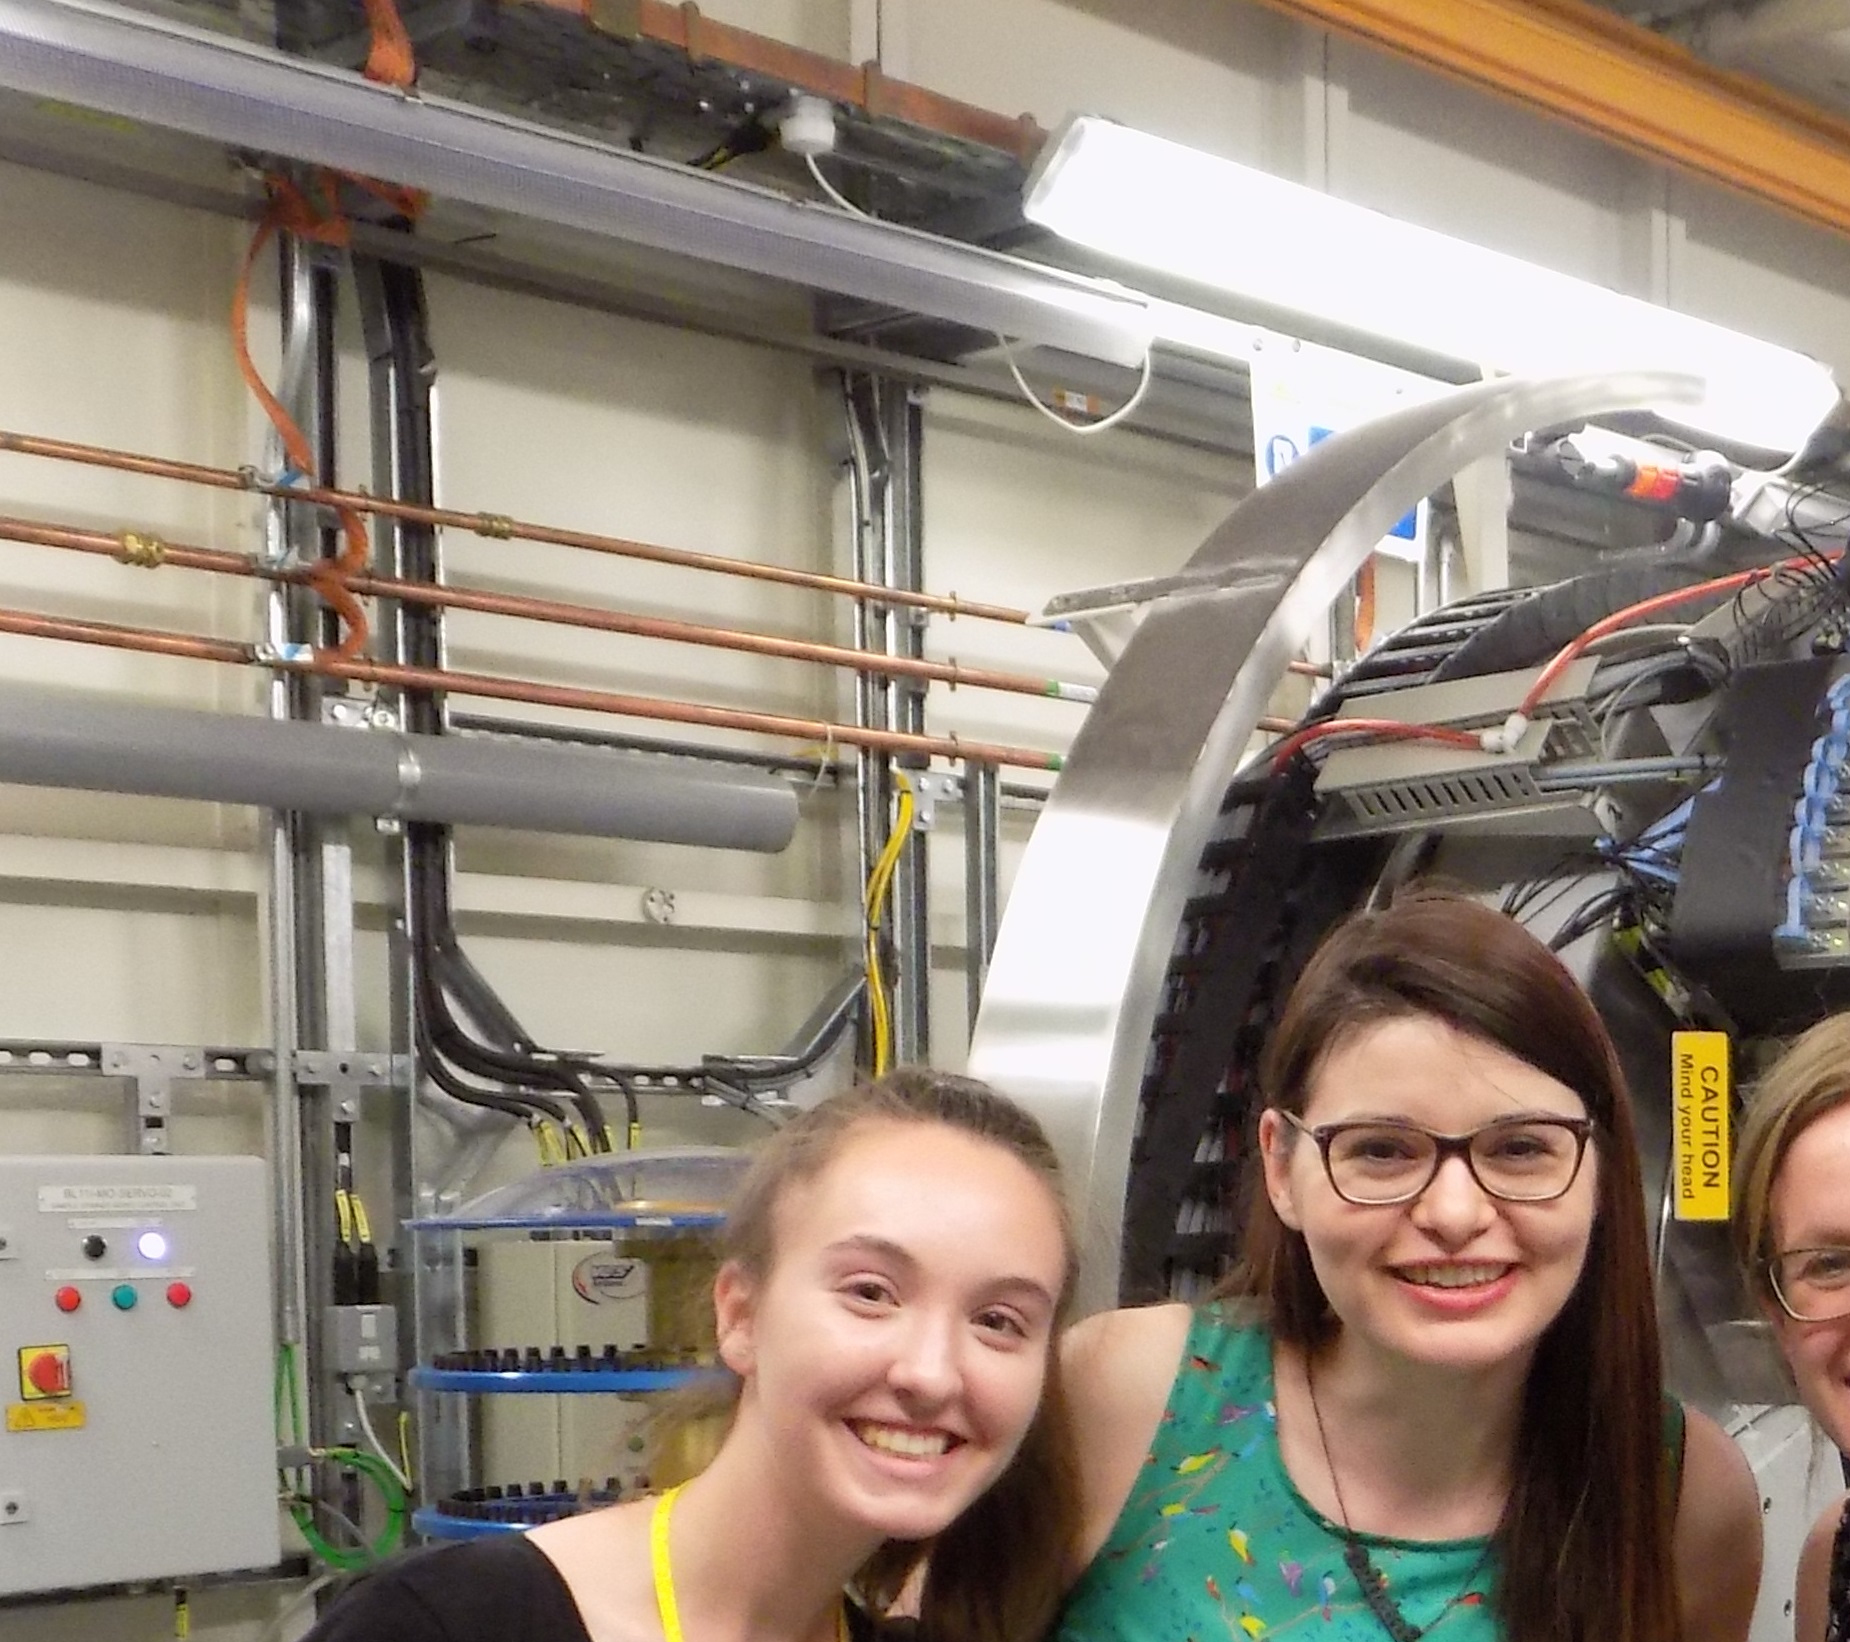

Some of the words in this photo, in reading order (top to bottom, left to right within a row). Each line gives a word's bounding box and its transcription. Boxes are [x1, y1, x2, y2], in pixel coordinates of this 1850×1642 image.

[1679, 1053, 1694, 1098] Mind
[1678, 1105, 1693, 1147] your
[1700, 1065, 1720, 1189] CAUTION
[1681, 1154, 1695, 1199] head
